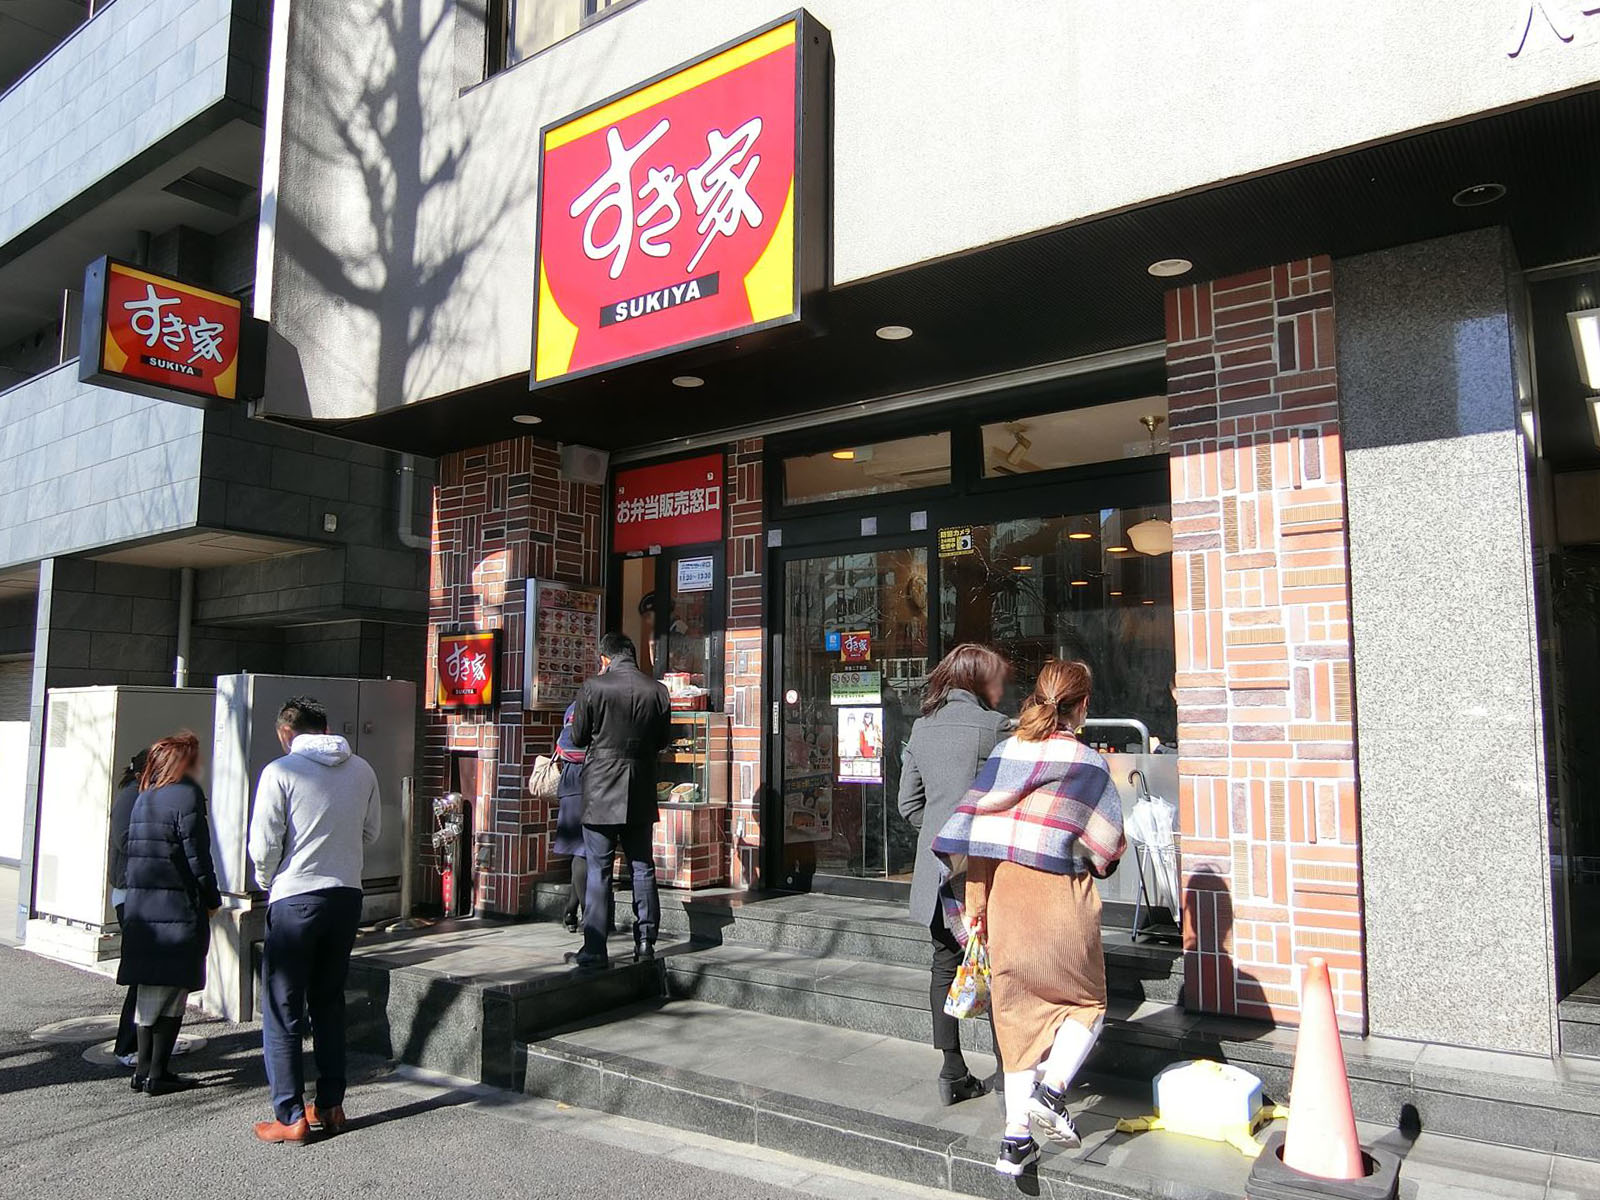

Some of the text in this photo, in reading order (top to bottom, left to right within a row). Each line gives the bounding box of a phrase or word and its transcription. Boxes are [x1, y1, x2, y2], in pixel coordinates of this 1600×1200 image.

[569, 116, 763, 280] すき家
[615, 280, 701, 322] SUKIYA
[123, 284, 225, 364] すき家
[149, 357, 194, 375] SUKIYA
[617, 486, 720, 524] お弁当販売窓口
[445, 642, 487, 687] すき家
[844, 635, 868, 652] すき家
